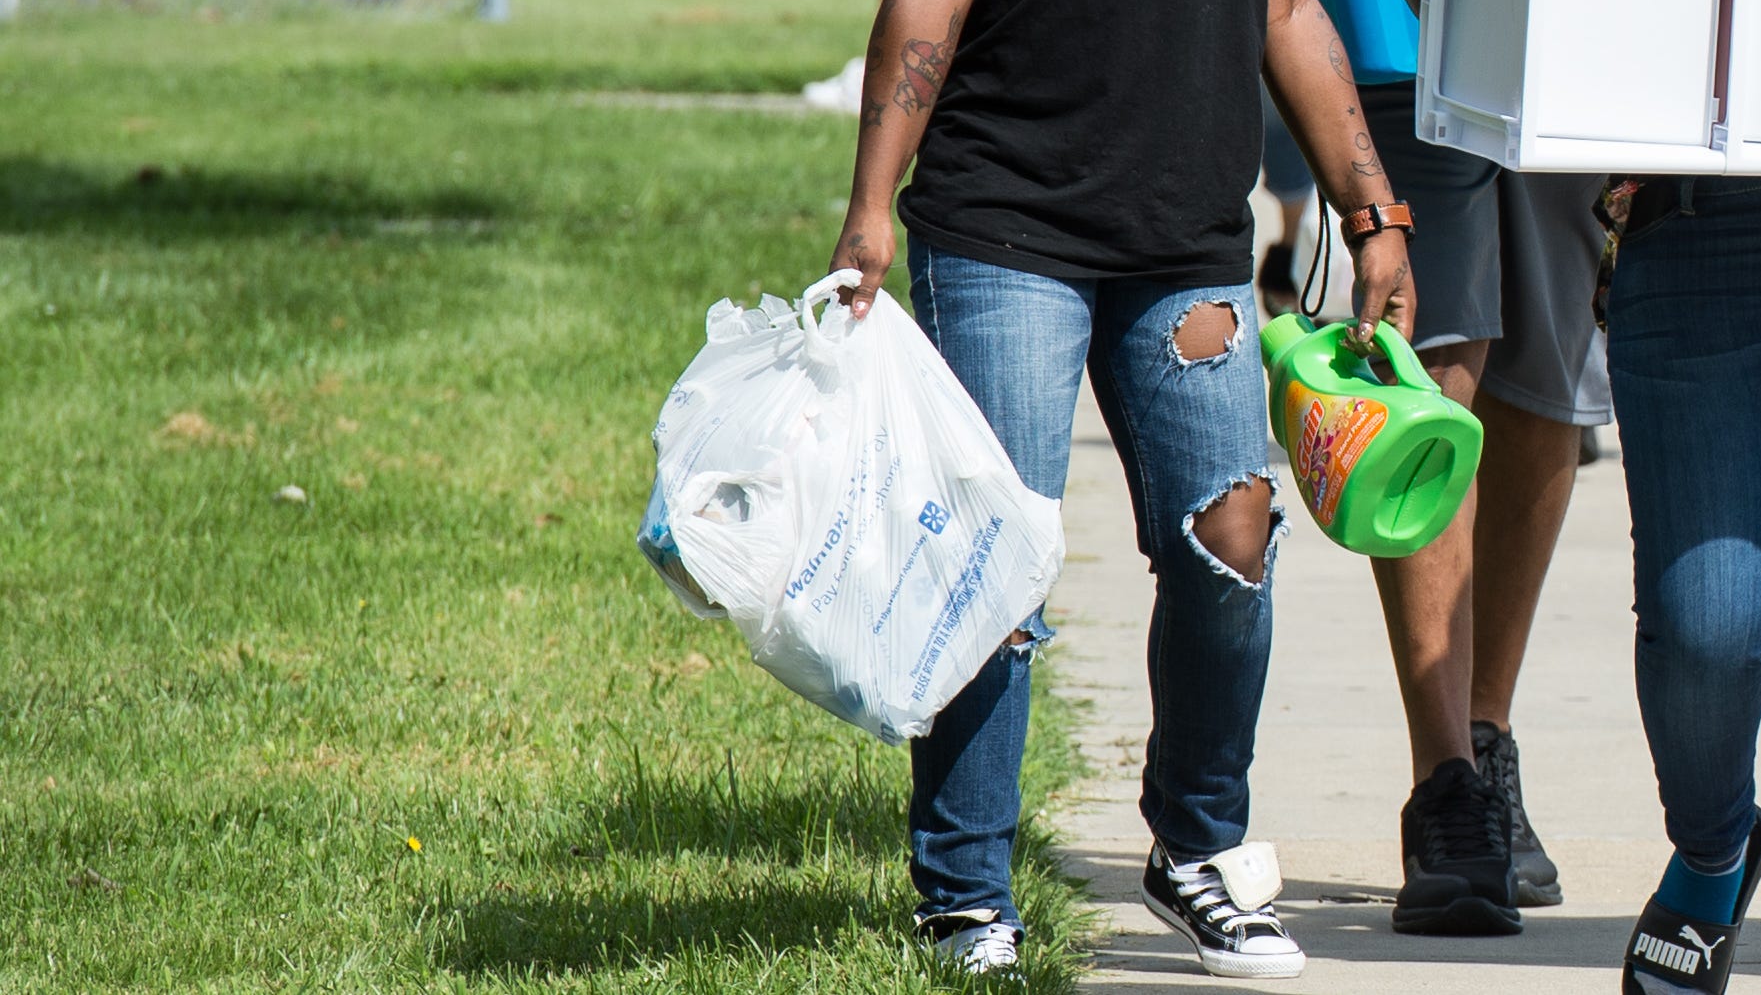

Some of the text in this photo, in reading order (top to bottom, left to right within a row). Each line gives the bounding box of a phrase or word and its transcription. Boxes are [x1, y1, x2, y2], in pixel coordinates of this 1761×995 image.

[1297, 398, 1324, 481] Gain
[901, 555, 915, 574] App
[933, 635, 947, 648] TO
[937, 629, 951, 639] A
[910, 672, 930, 701] PLEASE
[1633, 932, 1701, 975] PUMA
